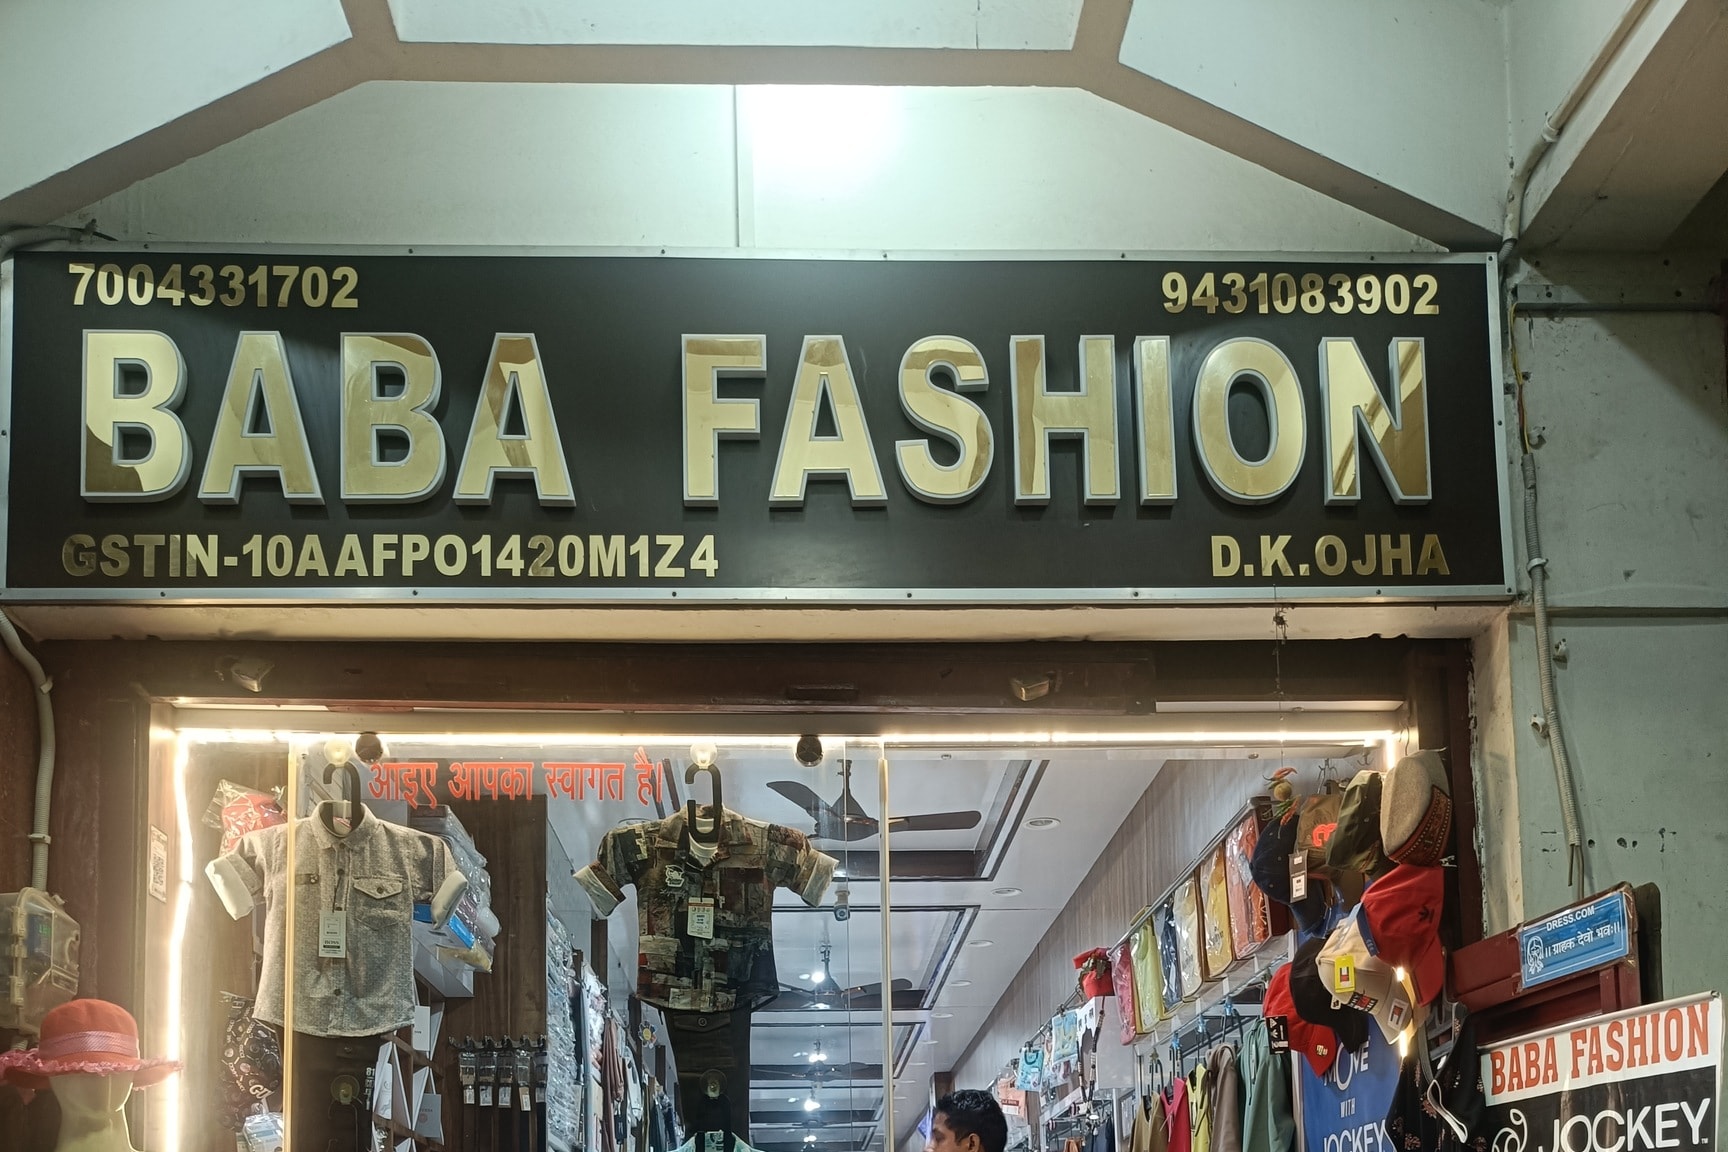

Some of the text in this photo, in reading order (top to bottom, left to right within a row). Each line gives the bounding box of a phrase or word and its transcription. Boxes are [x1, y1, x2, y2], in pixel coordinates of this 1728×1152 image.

[69, 263, 359, 308] 7004331702
[1161, 271, 1441, 316] 9431083902
[80, 328, 1434, 509] BABA FASHION
[368, 761, 438, 809] आइए
[448, 761, 534, 801] आपका
[541, 761, 626, 801] स्वागत
[1546, 904, 1596, 932] DRESS.COM
[1489, 1001, 1711, 1097] BABA FASHION
